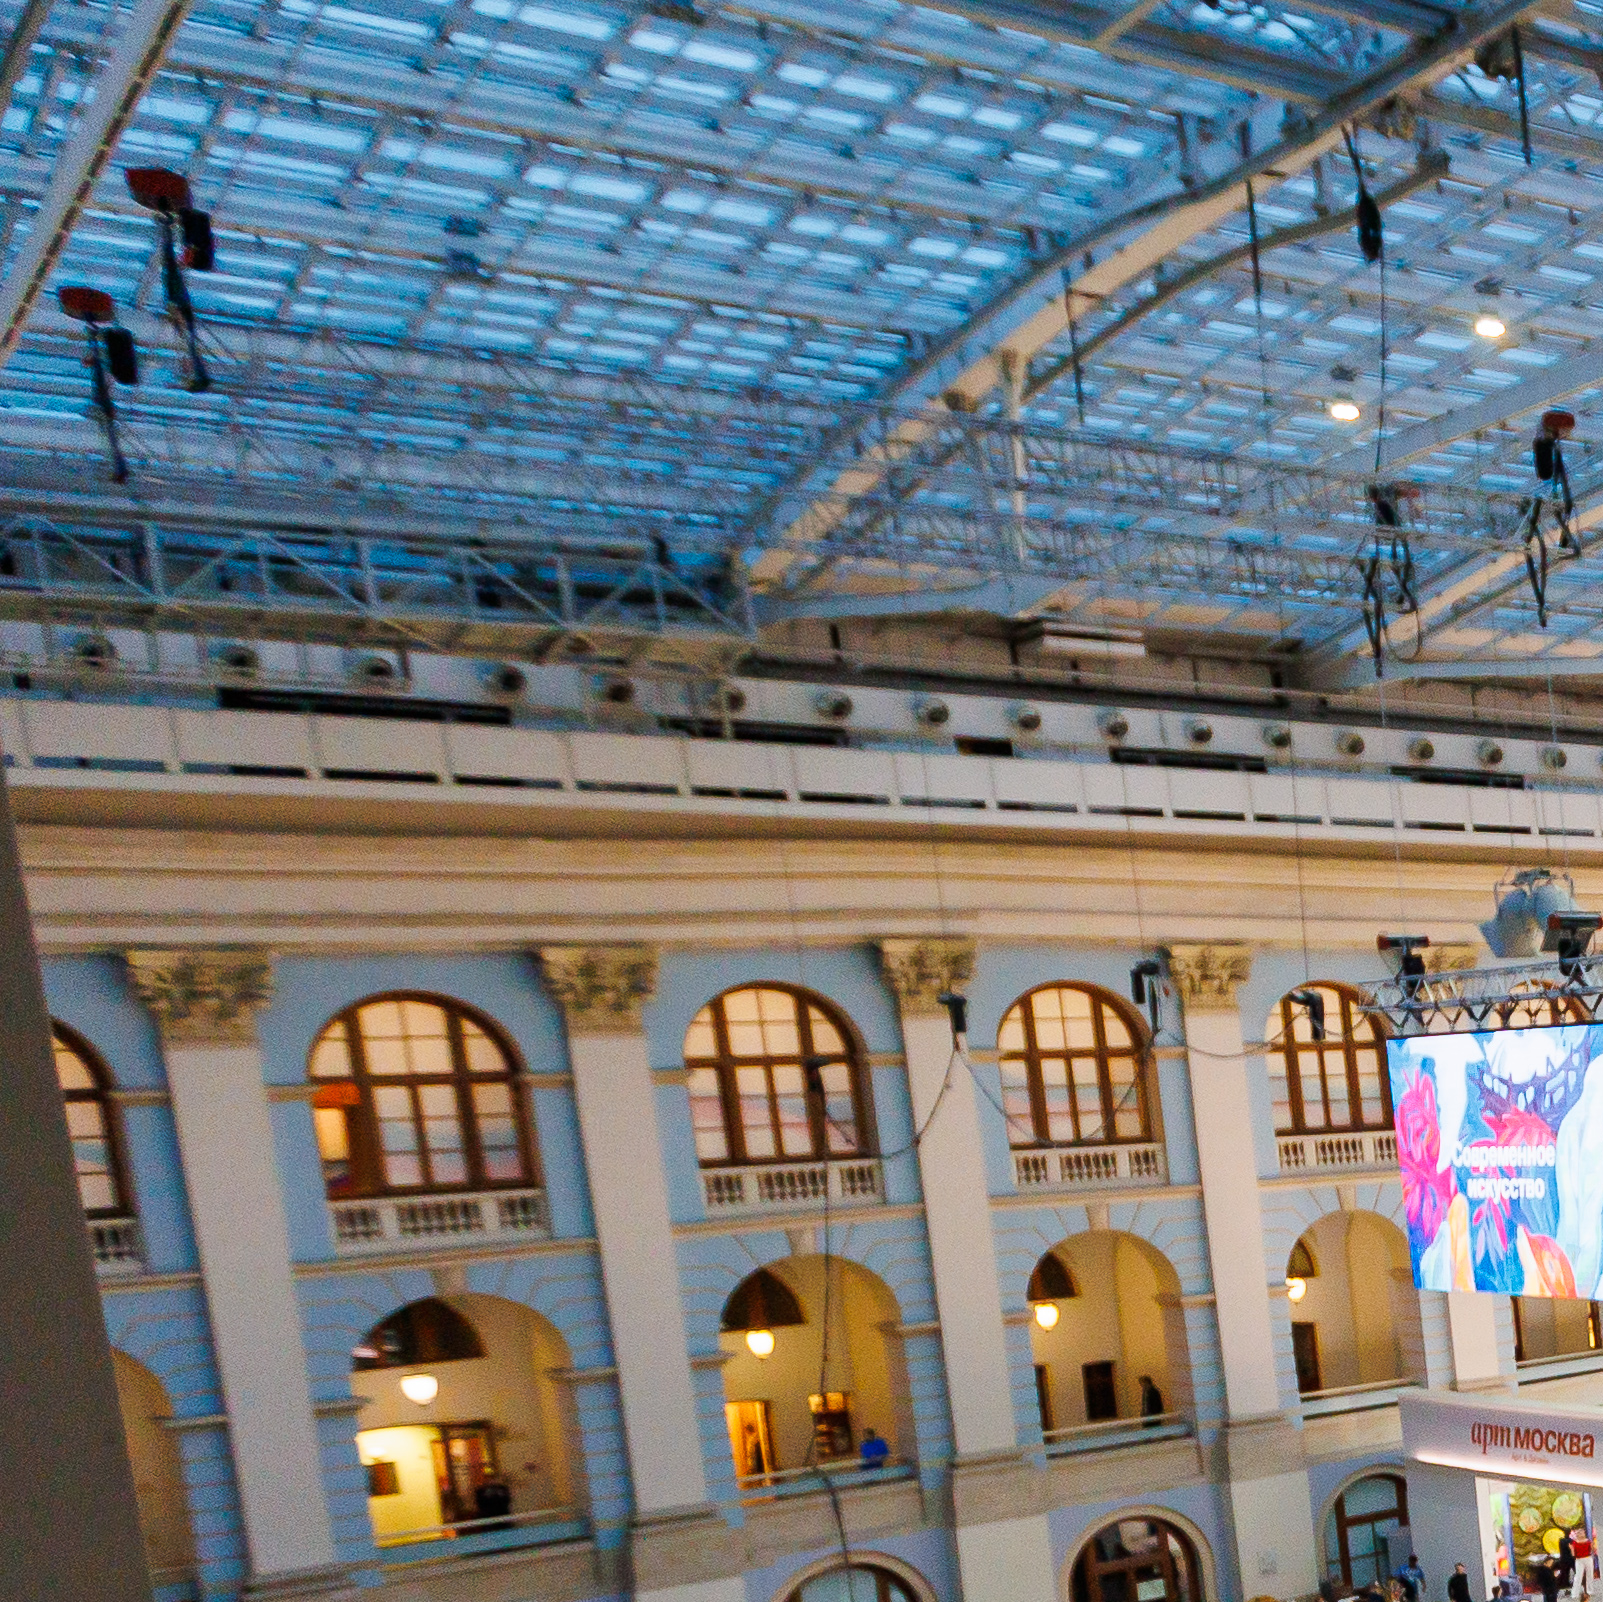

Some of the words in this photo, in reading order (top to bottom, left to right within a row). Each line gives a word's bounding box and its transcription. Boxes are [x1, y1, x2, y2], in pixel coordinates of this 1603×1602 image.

[1453, 1143, 1556, 1173] Современное
[1467, 1177, 1546, 1205] искусство
[1470, 1421, 1512, 1455] арт
